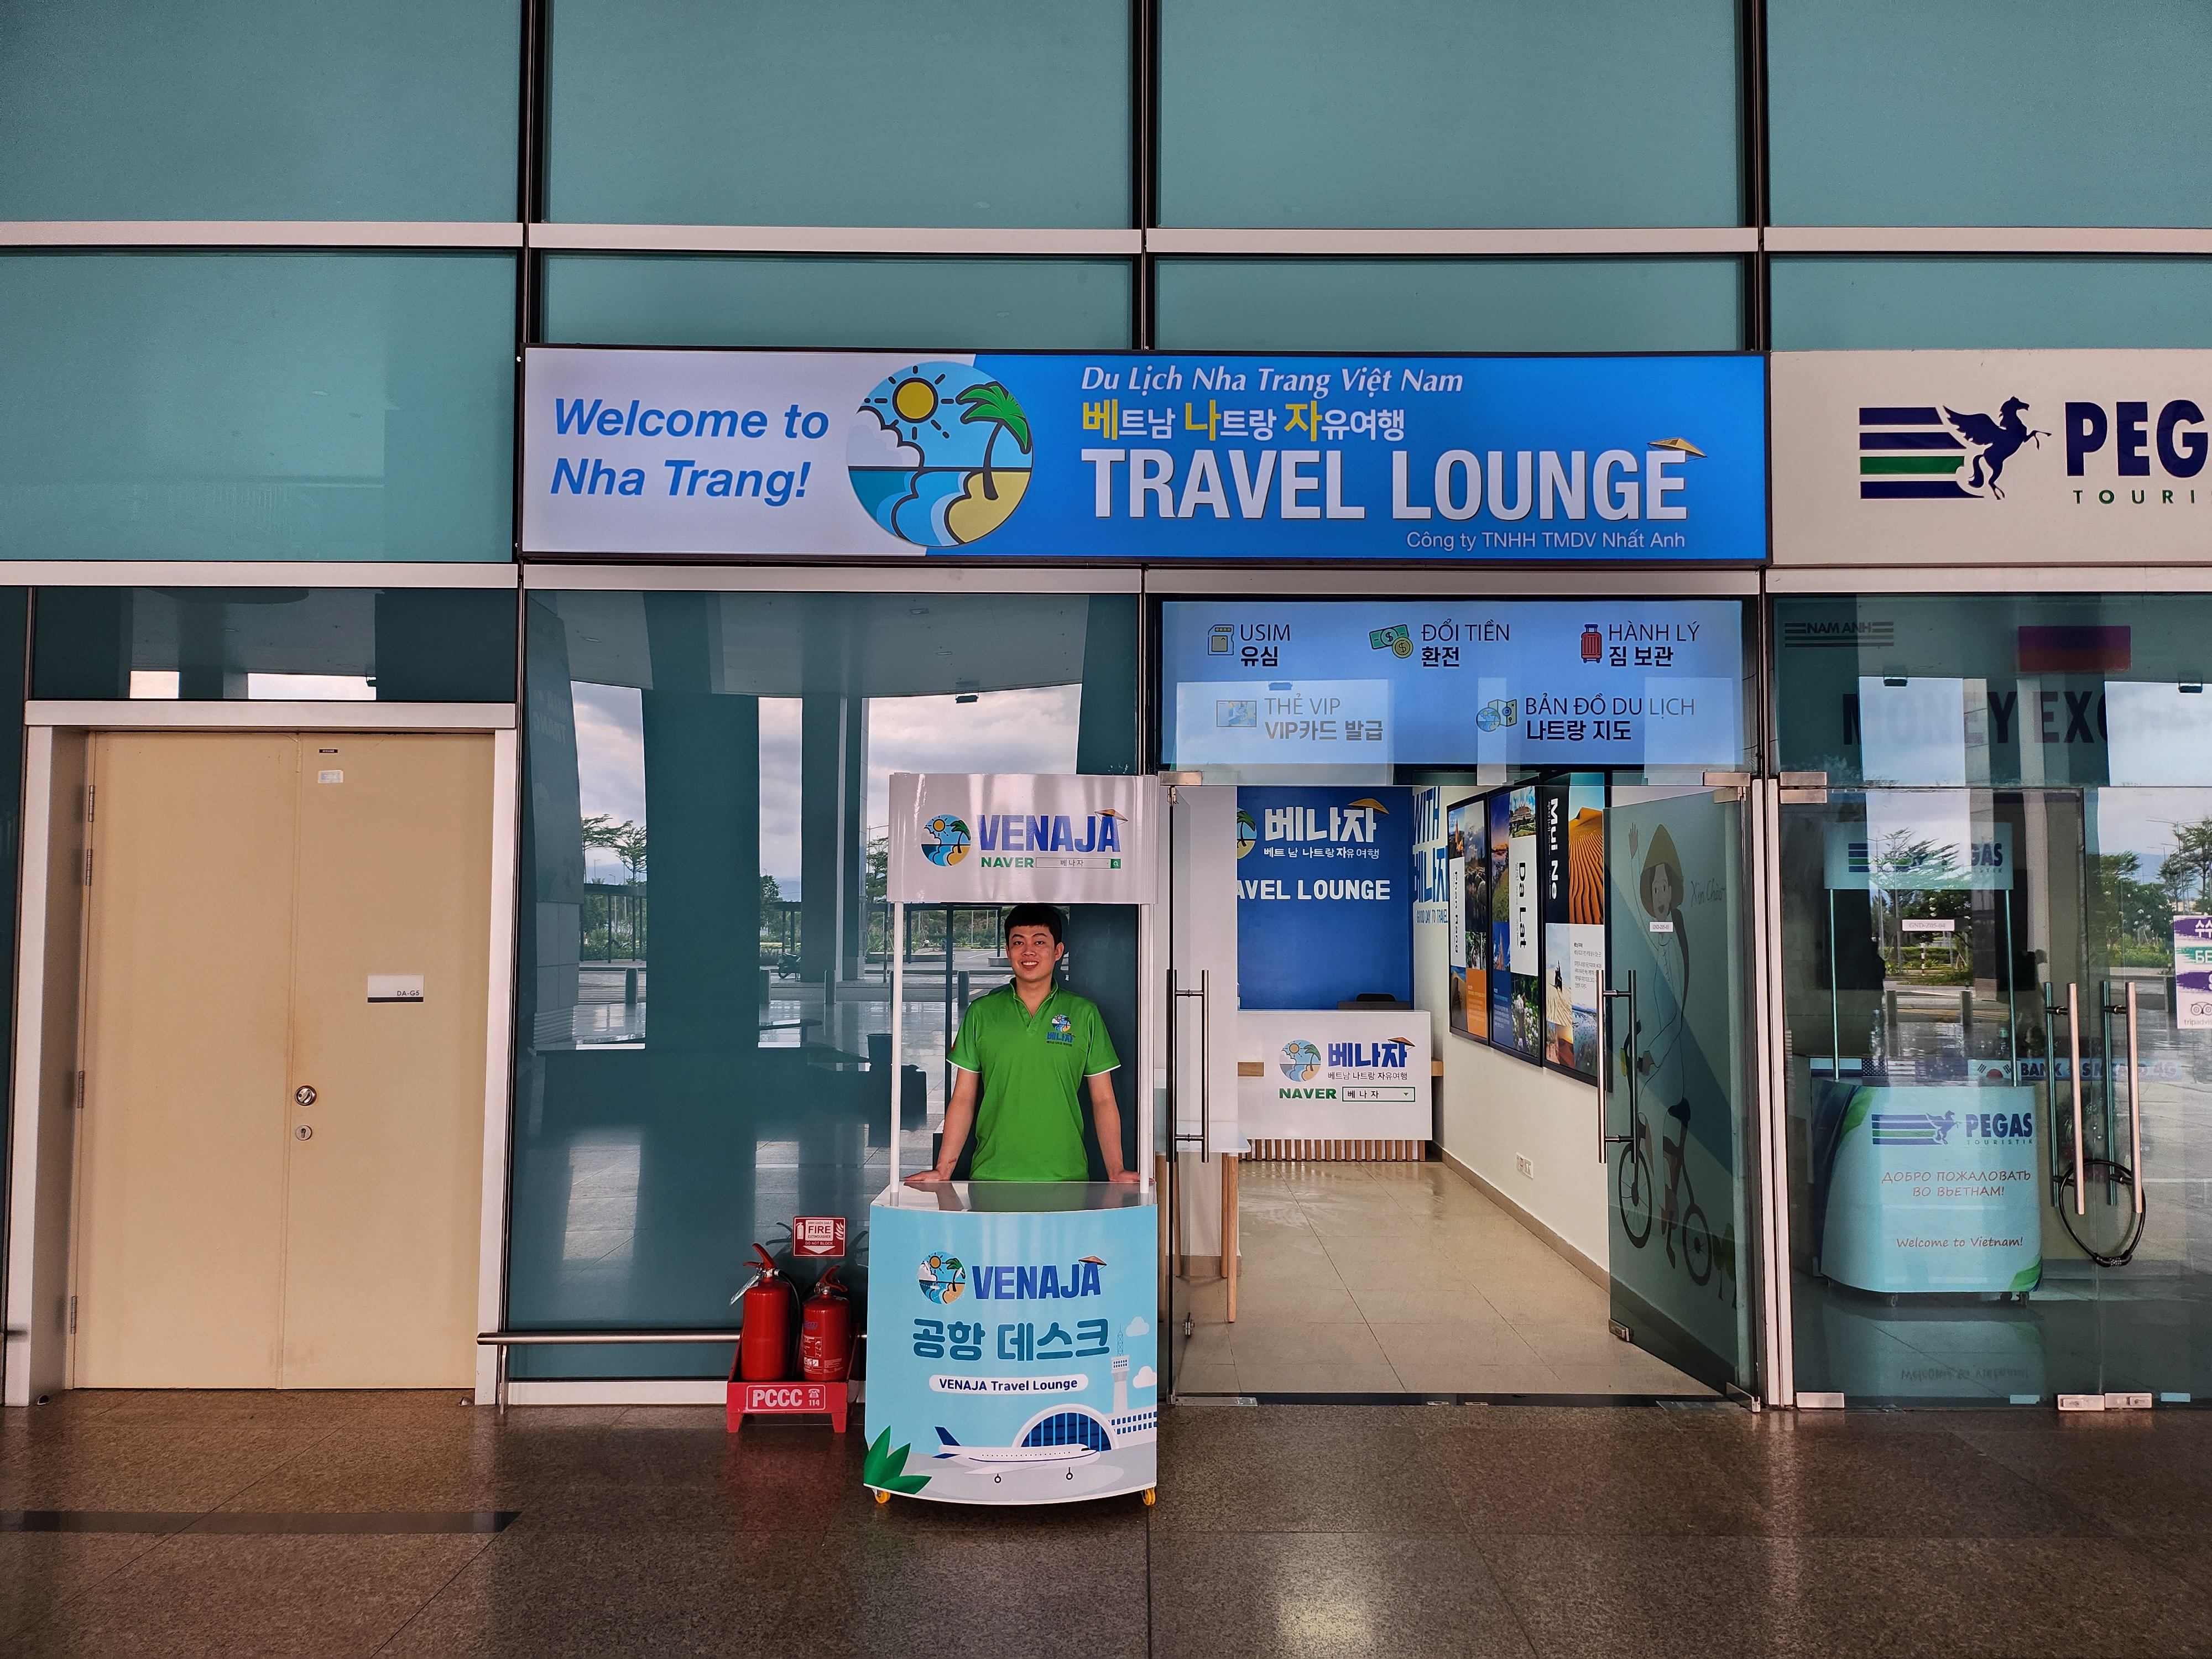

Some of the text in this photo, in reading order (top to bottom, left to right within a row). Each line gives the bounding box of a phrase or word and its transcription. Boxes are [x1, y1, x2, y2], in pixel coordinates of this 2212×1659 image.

[1082, 364, 1463, 399] Du Lịch Nha Trang Việt Nam
[554, 398, 830, 440] Welcome to
[1082, 398, 1405, 442] 베트남 나트랑 자유여행
[2064, 399, 2209, 479] PEG
[550, 458, 813, 507] Nha Trang!
[1081, 448, 1688, 521] TRAVEL LOUNGE
[2073, 489, 2212, 504] TOURI
[1407, 528, 1686, 552] Công ty TNHH TMDV Nhất Anh
[1239, 623, 1291, 642] USIM
[1421, 618, 1510, 642] ĐỔI TIỀN
[1608, 619, 1700, 642] HÀNH LÝ
[1807, 621, 1872, 634] NAM ANH
[1240, 646, 1279, 667] 유심
[1421, 645, 1460, 667] 환전
[1609, 645, 1674, 667] 짐 보관
[1264, 692, 1341, 716] THẺ VIP
[1525, 692, 1695, 719] BẢN ĐỒ DU LỊCH
[1264, 720, 1384, 741] VIP카드 발급
[1526, 720, 1632, 742] 나트랑 지도
[1264, 806, 1377, 843] 베나자
[1413, 786, 1441, 844] WITH
[977, 814, 1121, 853] VENAJA
[980, 857, 1034, 868] NAVER
[1302, 846, 1335, 859] 나트랑
[1297, 879, 1391, 900] LOUNGE
[1519, 862, 1526, 898] Da
[1551, 860, 1558, 900] Ne
[1328, 1042, 1408, 1068] 베나자
[1327, 1071, 1408, 1081] 베트남 나트랑 자유여행
[1279, 1088, 1337, 1099] NAVER
[1965, 1113, 2033, 1138] PEGAS
[1881, 1170, 2031, 1184] ДОБРО ПОЖАЛОВАТЬ
[1913, 1186, 2005, 1197] ВО ВЬЕТНАМ!
[808, 1225, 831, 1234] FIRE
[1896, 1237, 2023, 1248] Welcome to Vietnam!
[972, 1262, 1102, 1300] VENAJA
[912, 1317, 1110, 1361] 공항 데스크
[939, 1378, 1078, 1391] VENAJA Travel Lounge
[752, 1388, 803, 1407] PCCC
[808, 1399, 820, 1407] 114
